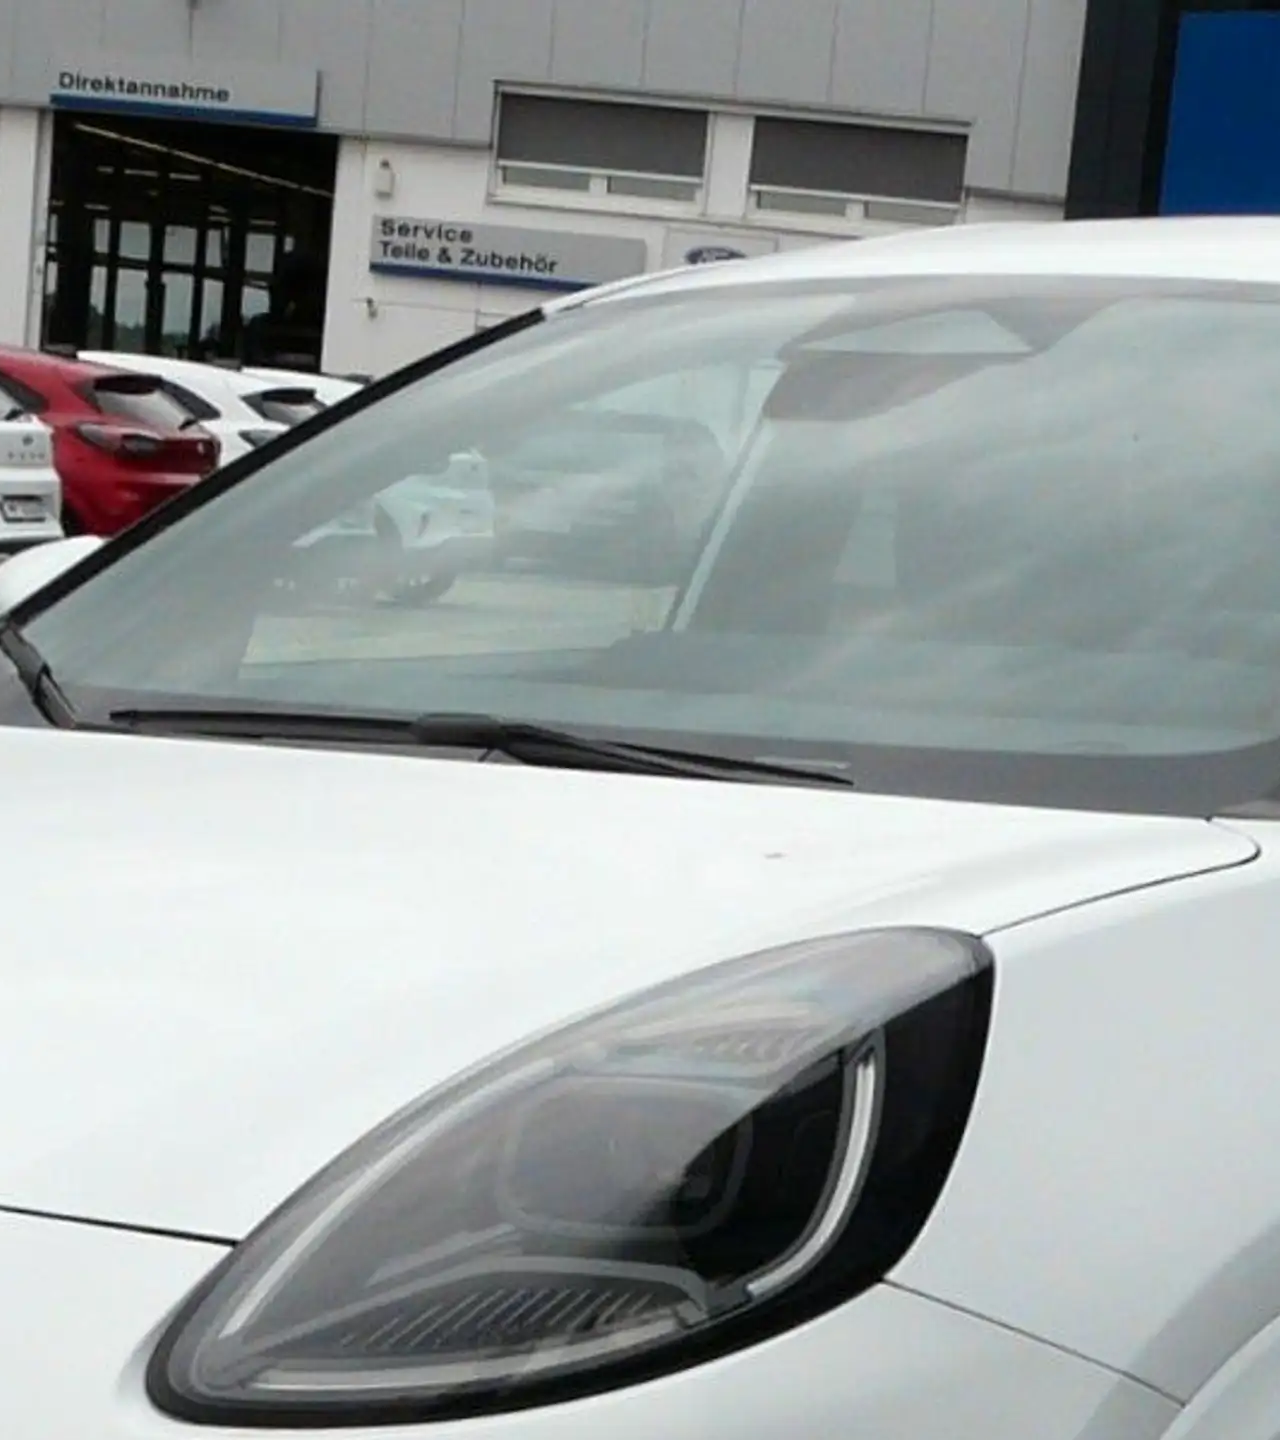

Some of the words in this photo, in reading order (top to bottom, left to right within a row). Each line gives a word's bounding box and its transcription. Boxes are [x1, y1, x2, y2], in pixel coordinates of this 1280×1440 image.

[58, 72, 230, 102] Direktannahme
[380, 218, 474, 244] Service
[380, 240, 430, 263] Teile
[437, 246, 452, 264] &
[460, 248, 559, 274] Zubehör
